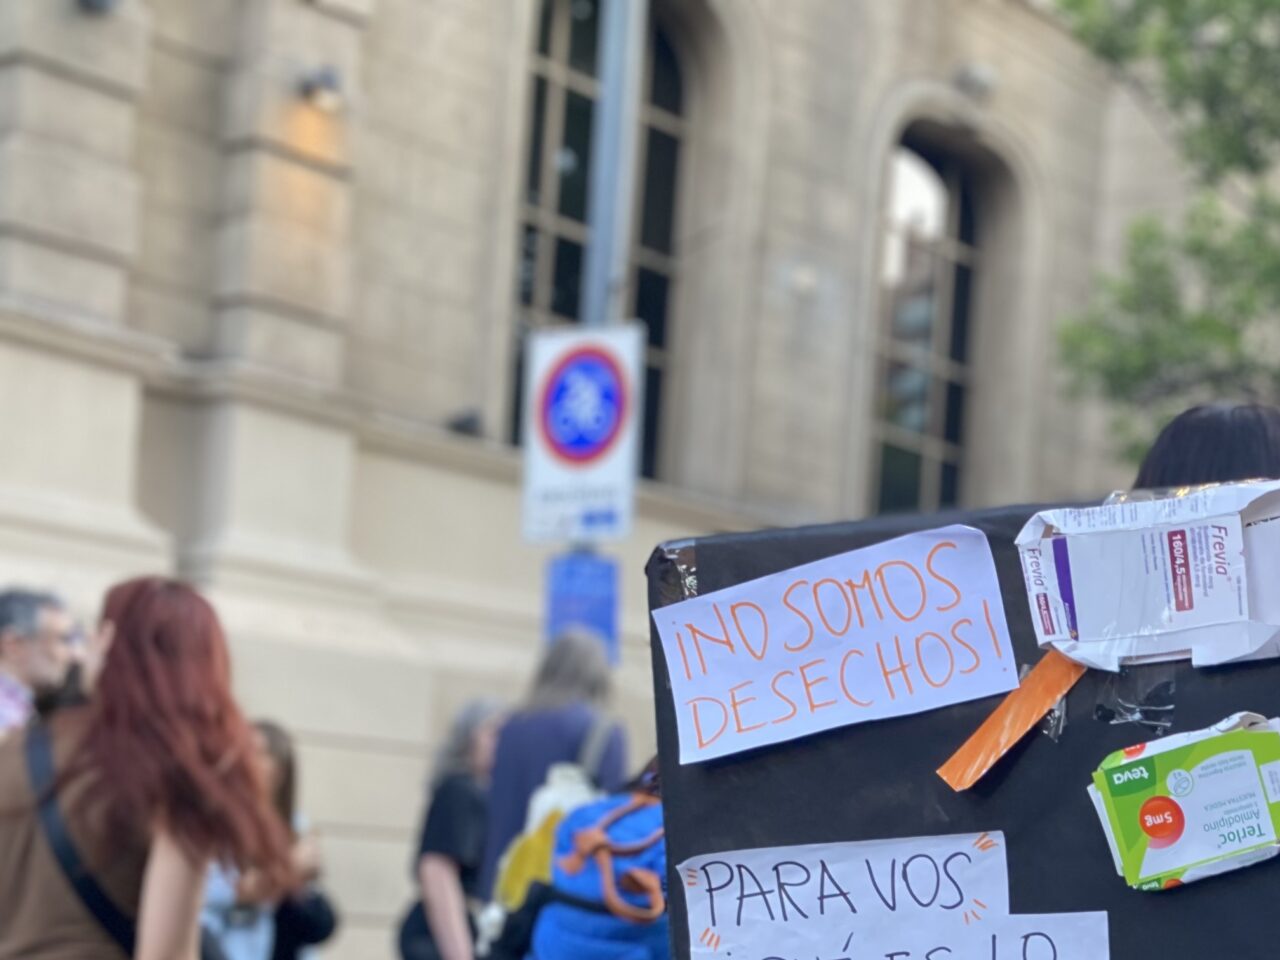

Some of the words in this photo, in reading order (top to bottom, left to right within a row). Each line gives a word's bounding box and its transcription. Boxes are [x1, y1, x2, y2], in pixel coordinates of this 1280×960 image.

[1027, 548, 1045, 587] Frevia
[1171, 534, 1186, 575] 160/4,5
[1211, 524, 1229, 576] Frevia
[672, 601, 769, 681] ¡NO
[782, 542, 961, 652] SOMOS
[686, 599, 1007, 749] DESECHOS!
[1112, 766, 1149, 785] teva
[1203, 809, 1261, 832] Amlodipino
[1219, 823, 1266, 846] Terloc
[700, 859, 857, 927] PARA
[865, 852, 971, 911] VOS
